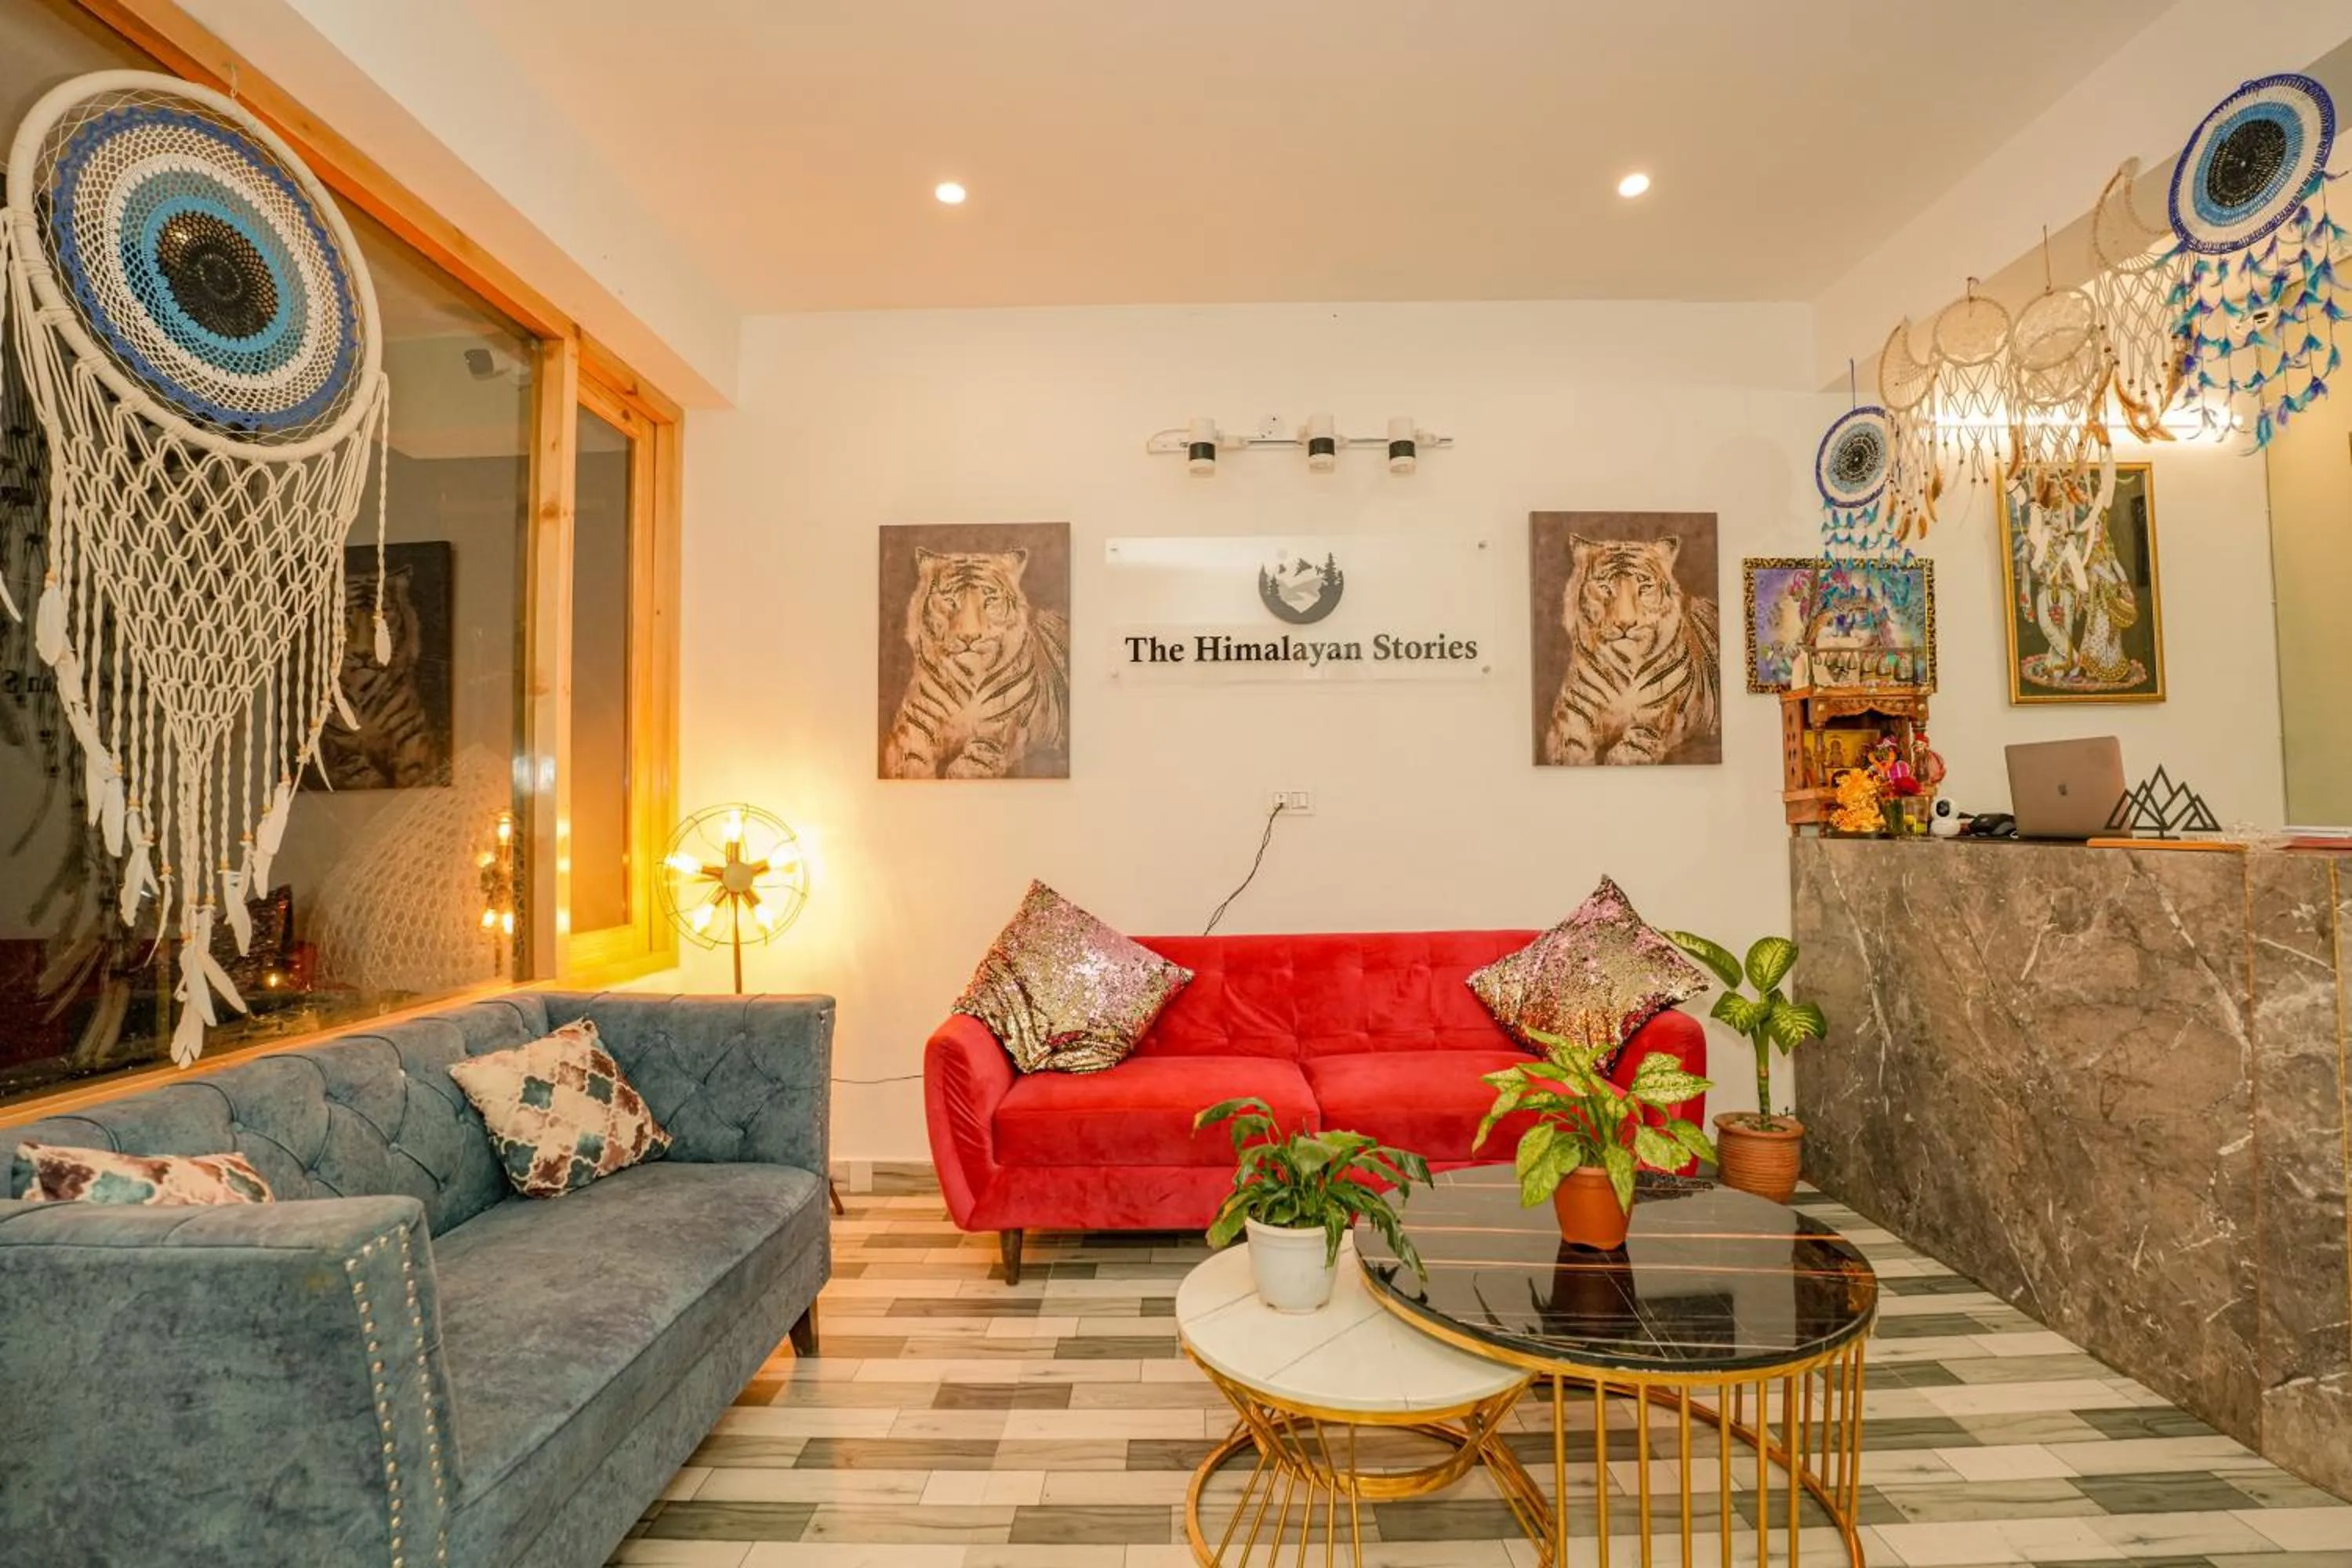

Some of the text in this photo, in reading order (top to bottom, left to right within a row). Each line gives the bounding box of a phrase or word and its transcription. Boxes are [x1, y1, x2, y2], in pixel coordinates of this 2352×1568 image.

[1124, 633, 1478, 667] The Himalayan Stories
